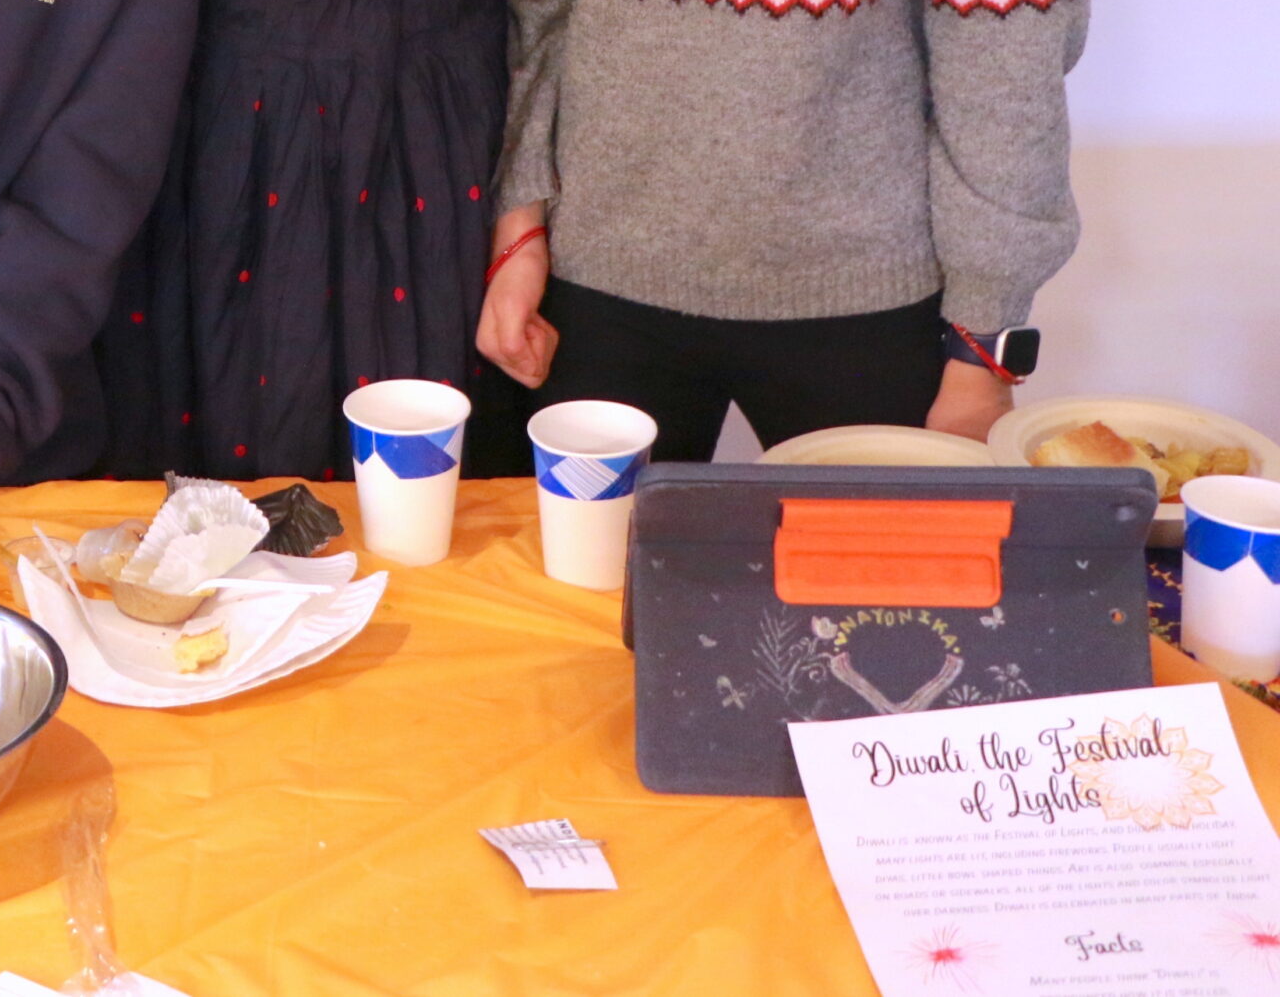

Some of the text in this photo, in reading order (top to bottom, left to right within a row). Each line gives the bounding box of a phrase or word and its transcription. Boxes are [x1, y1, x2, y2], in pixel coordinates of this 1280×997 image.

[979, 731, 1033, 773] the
[1037, 717, 1171, 774] Festival
[960, 773, 1102, 825] of Lights
[1101, 826, 1125, 835] AND
[946, 853, 966, 862] ARE
[1064, 930, 1144, 961] Facts
